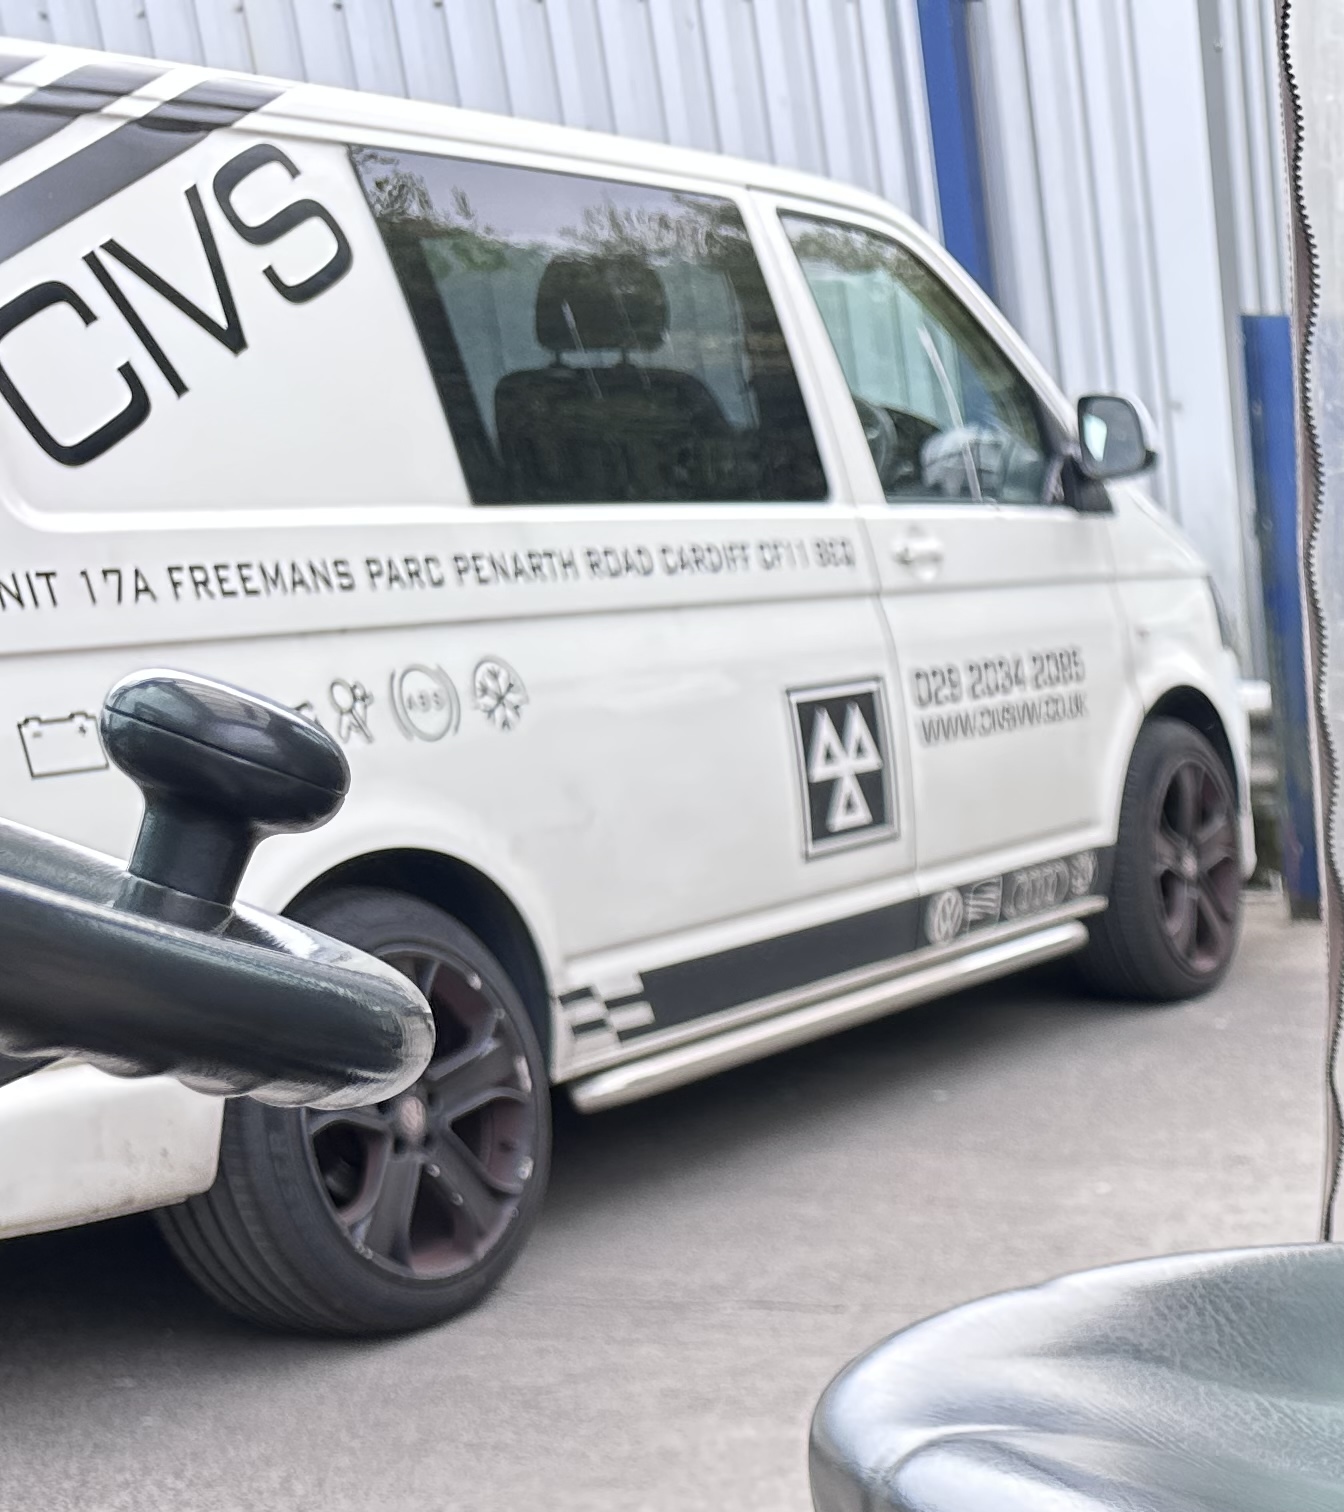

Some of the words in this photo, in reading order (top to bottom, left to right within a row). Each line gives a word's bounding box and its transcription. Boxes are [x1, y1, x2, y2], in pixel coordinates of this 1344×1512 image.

[0, 143, 354, 467] CIVS
[80, 565, 157, 607] 17A
[166, 556, 355, 602] FREEMANS
[365, 555, 445, 591] PARC
[452, 547, 577, 586] PENARTH
[584, 545, 654, 578] ROAD
[660, 541, 752, 576] CARDIFF
